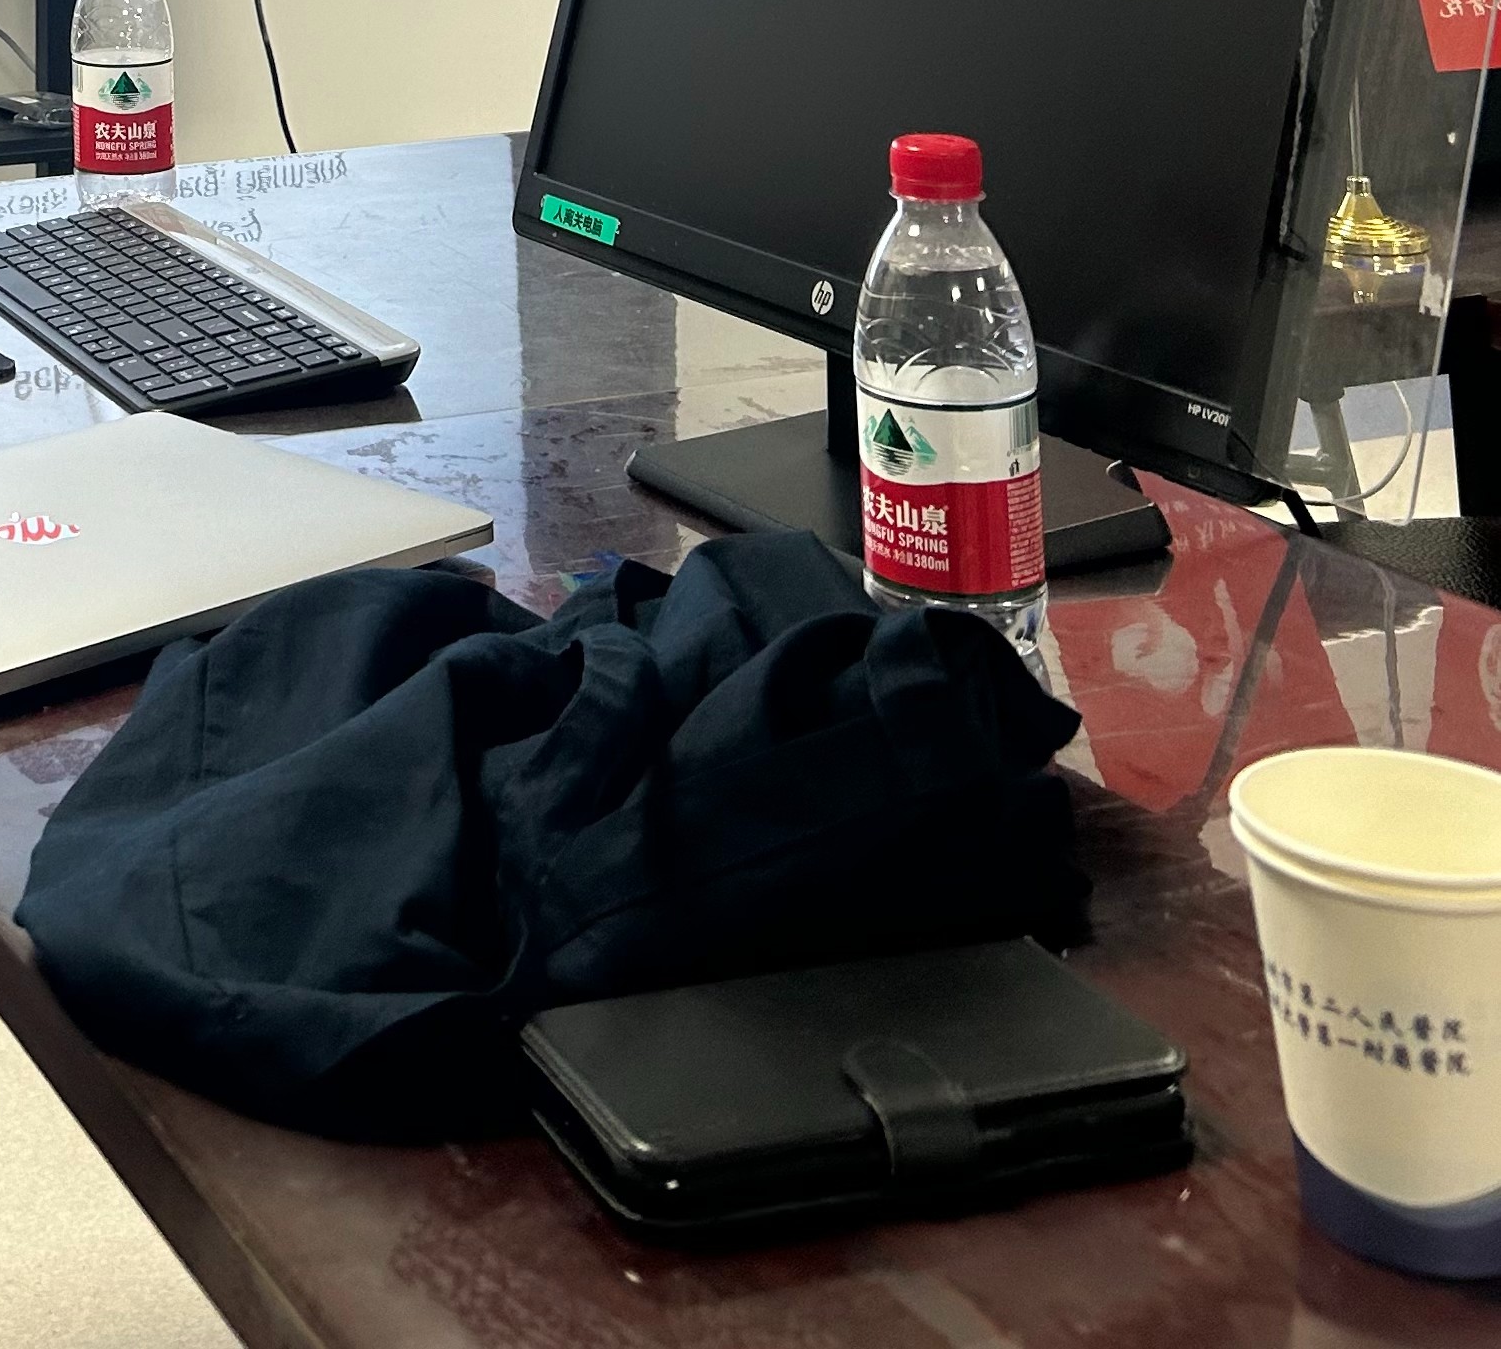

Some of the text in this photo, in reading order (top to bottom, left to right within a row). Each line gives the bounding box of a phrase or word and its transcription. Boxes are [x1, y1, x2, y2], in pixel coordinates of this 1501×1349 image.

[94, 121, 157, 141] 农夫山泉
[1187, 402, 1202, 416] HP
[898, 532, 949, 555] SPRING
